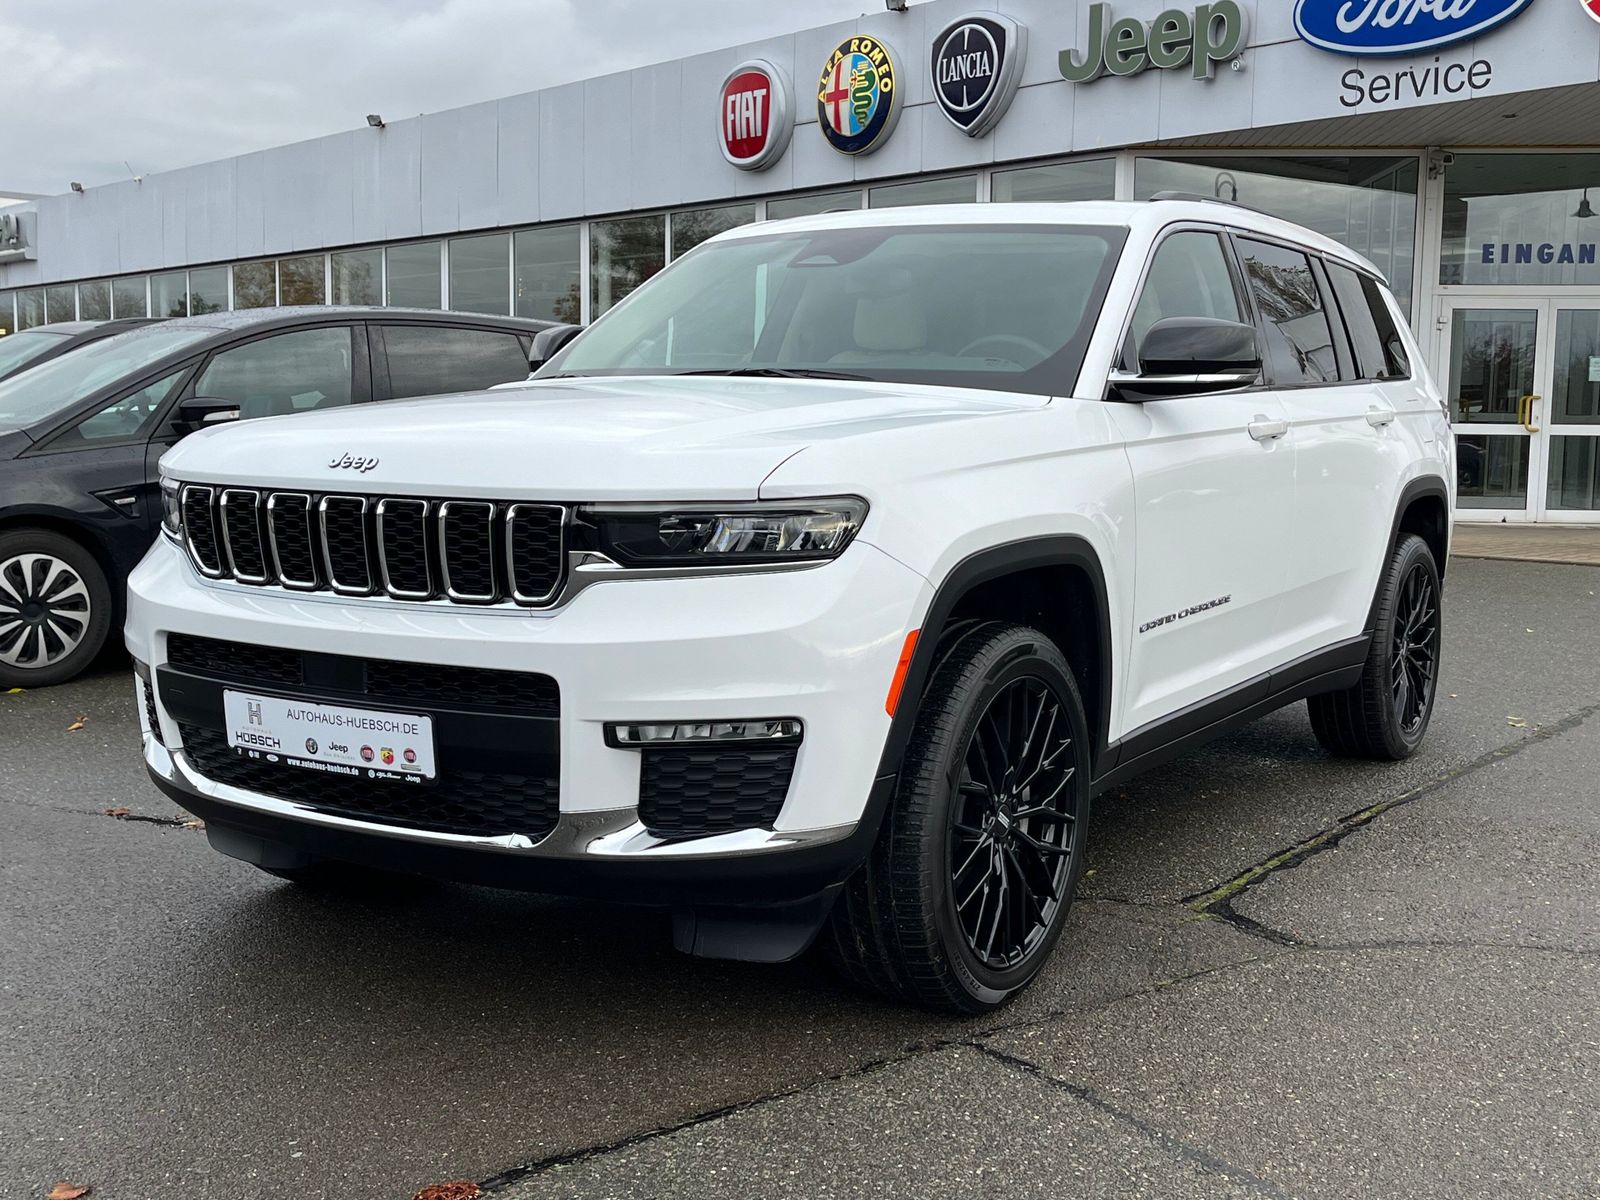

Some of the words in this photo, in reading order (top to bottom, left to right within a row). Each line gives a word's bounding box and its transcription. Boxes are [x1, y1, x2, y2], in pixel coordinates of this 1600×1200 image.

[1058, 0, 1243, 82] Jeep
[816, 49, 844, 104] ALFA
[849, 37, 892, 93] ROMEO
[941, 50, 992, 84] LANCIA
[1339, 56, 1492, 107] Service
[727, 88, 767, 142] FIAT
[1481, 243, 1596, 264] EINGAN
[328, 451, 379, 473] Jeep
[287, 708, 419, 735] AUTOHAUS-HUEBSCH.DE
[328, 741, 349, 754] Jeep
